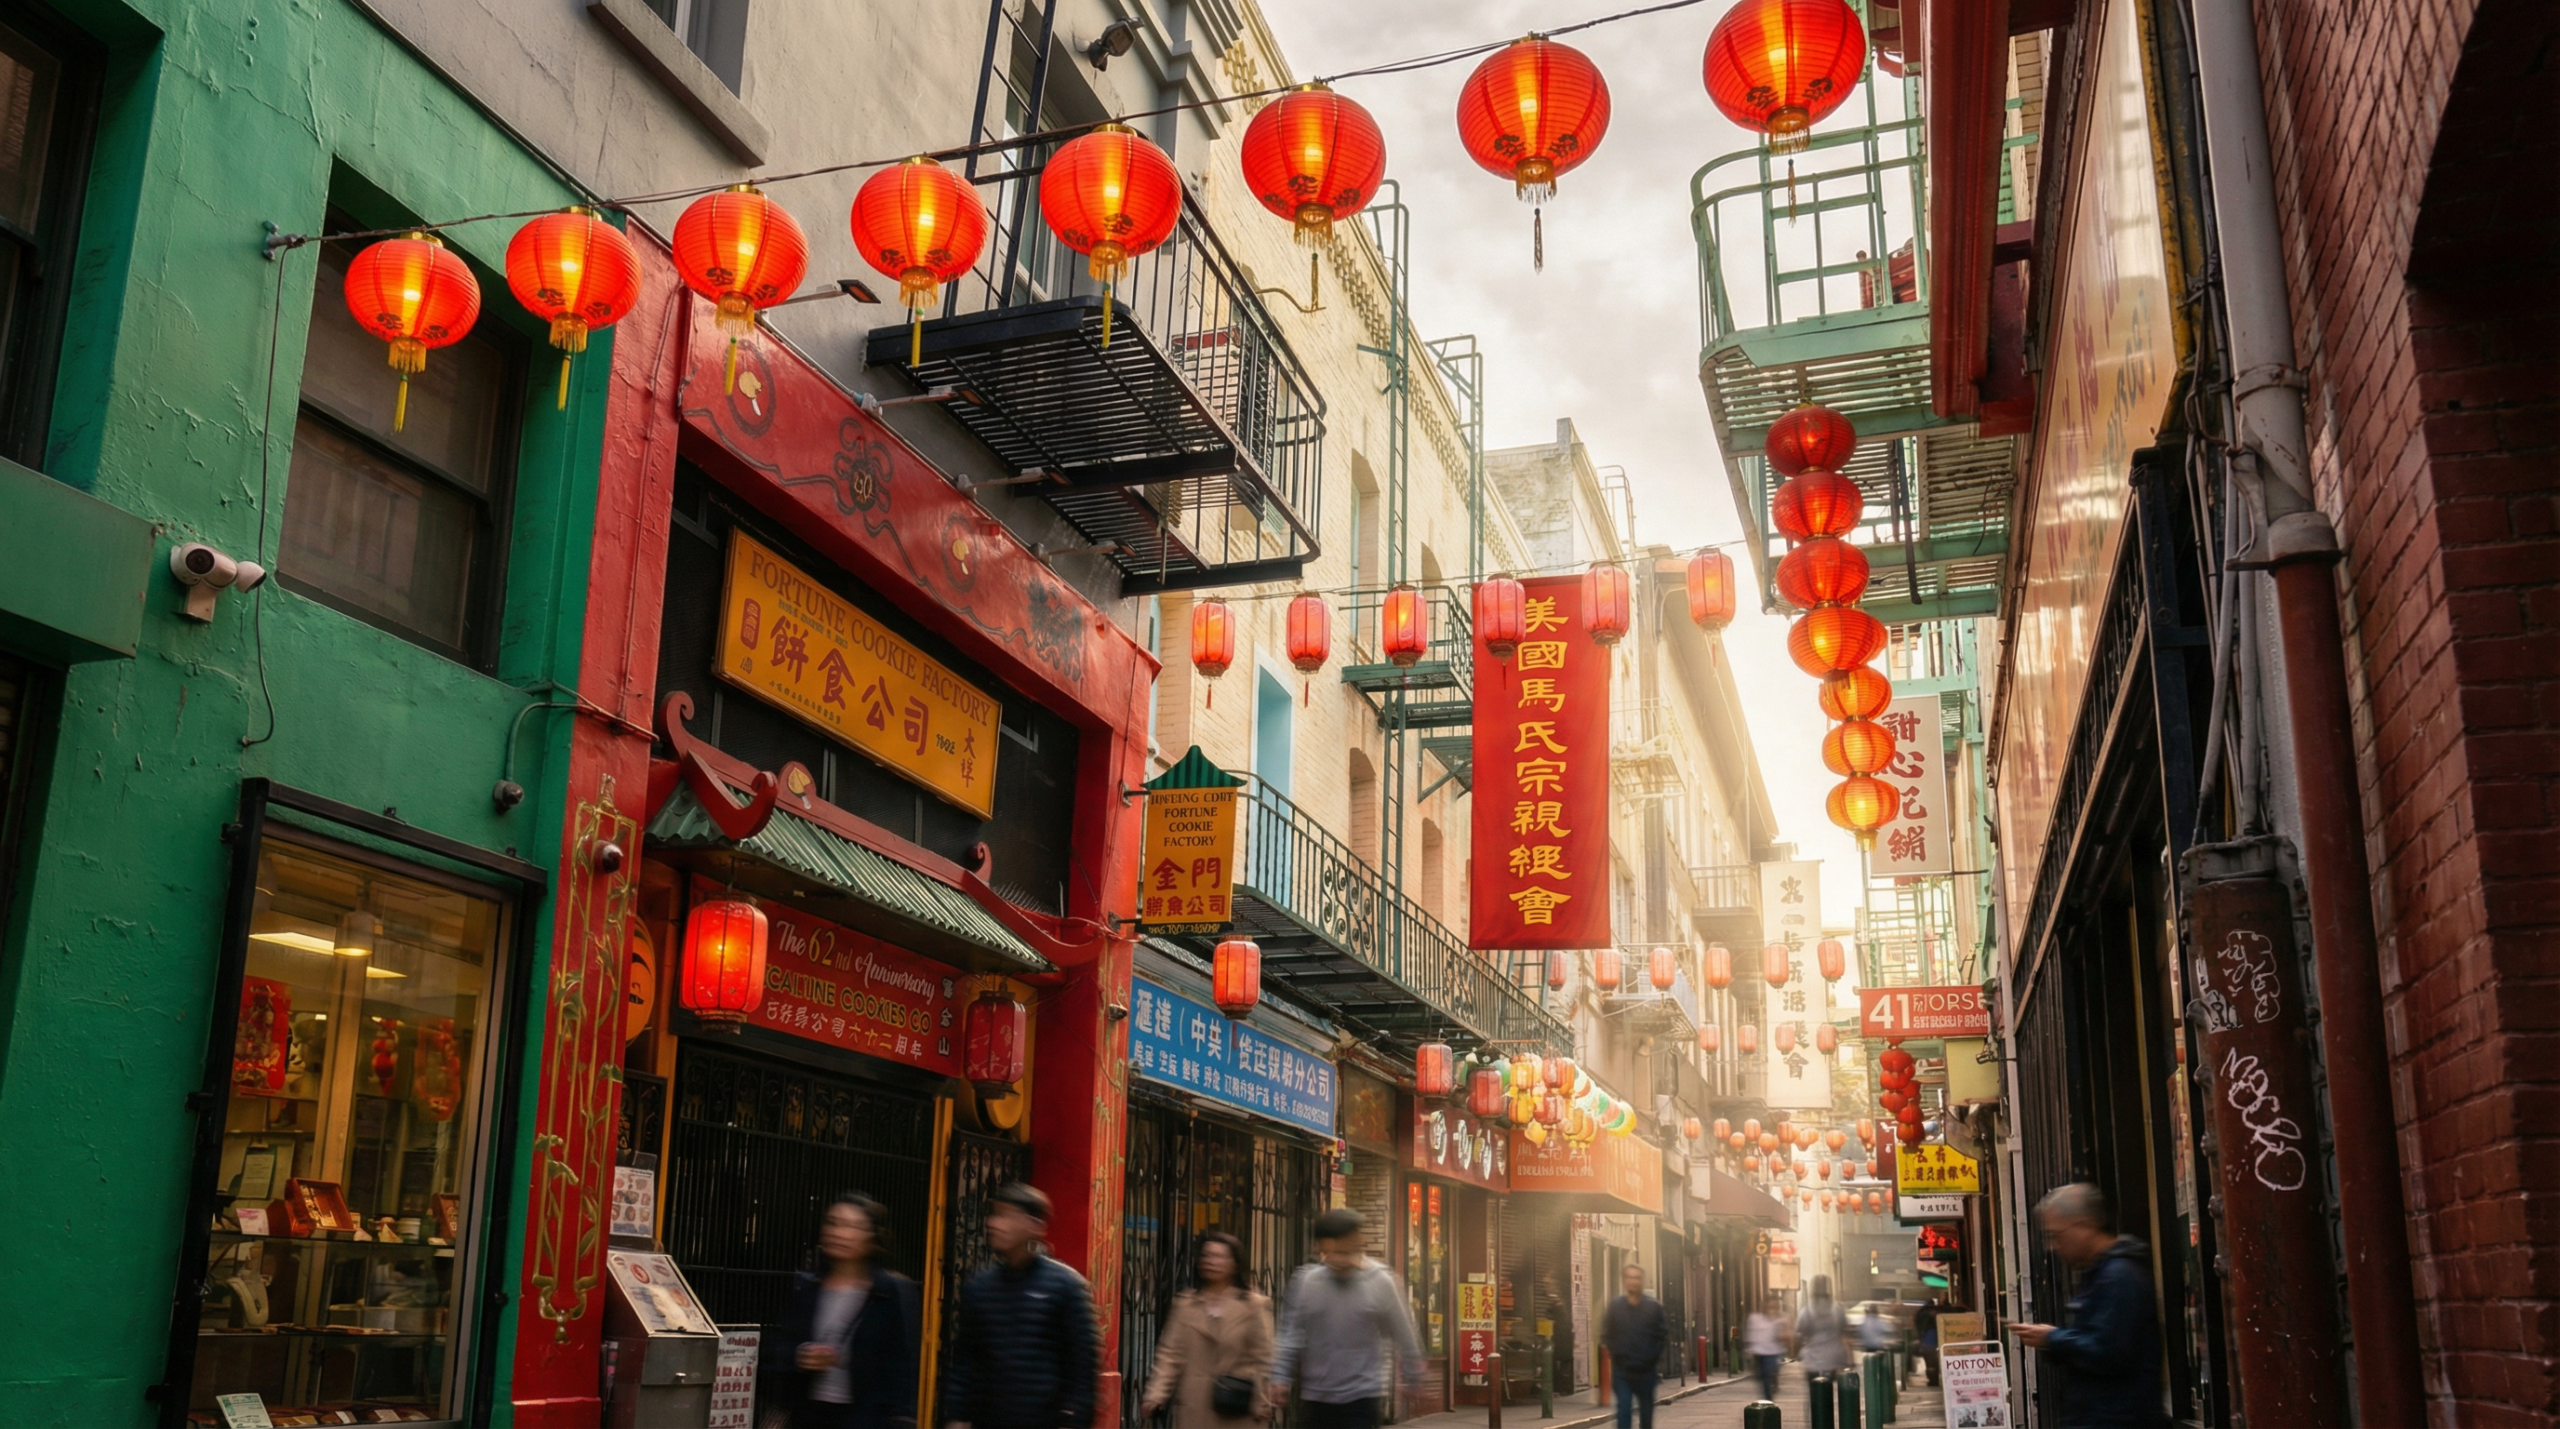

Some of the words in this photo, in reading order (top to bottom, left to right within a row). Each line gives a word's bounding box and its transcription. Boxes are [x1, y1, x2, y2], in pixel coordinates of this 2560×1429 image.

[749, 551, 846, 635] FORTUNE
[851, 618, 917, 680] COOKIE
[920, 667, 992, 727] FACTORY
[769, 614, 930, 757] 餅食公司
[1164, 807, 1218, 818] FORTUNE
[1169, 821, 1213, 832] COOKIE
[1163, 835, 1217, 847] FACTORY
[1152, 857, 1221, 891] 金門
[776, 920, 807, 956] The
[840, 987, 906, 1028] COOKIES
[910, 1009, 932, 1036] CO
[1869, 994, 1910, 1030] 41
